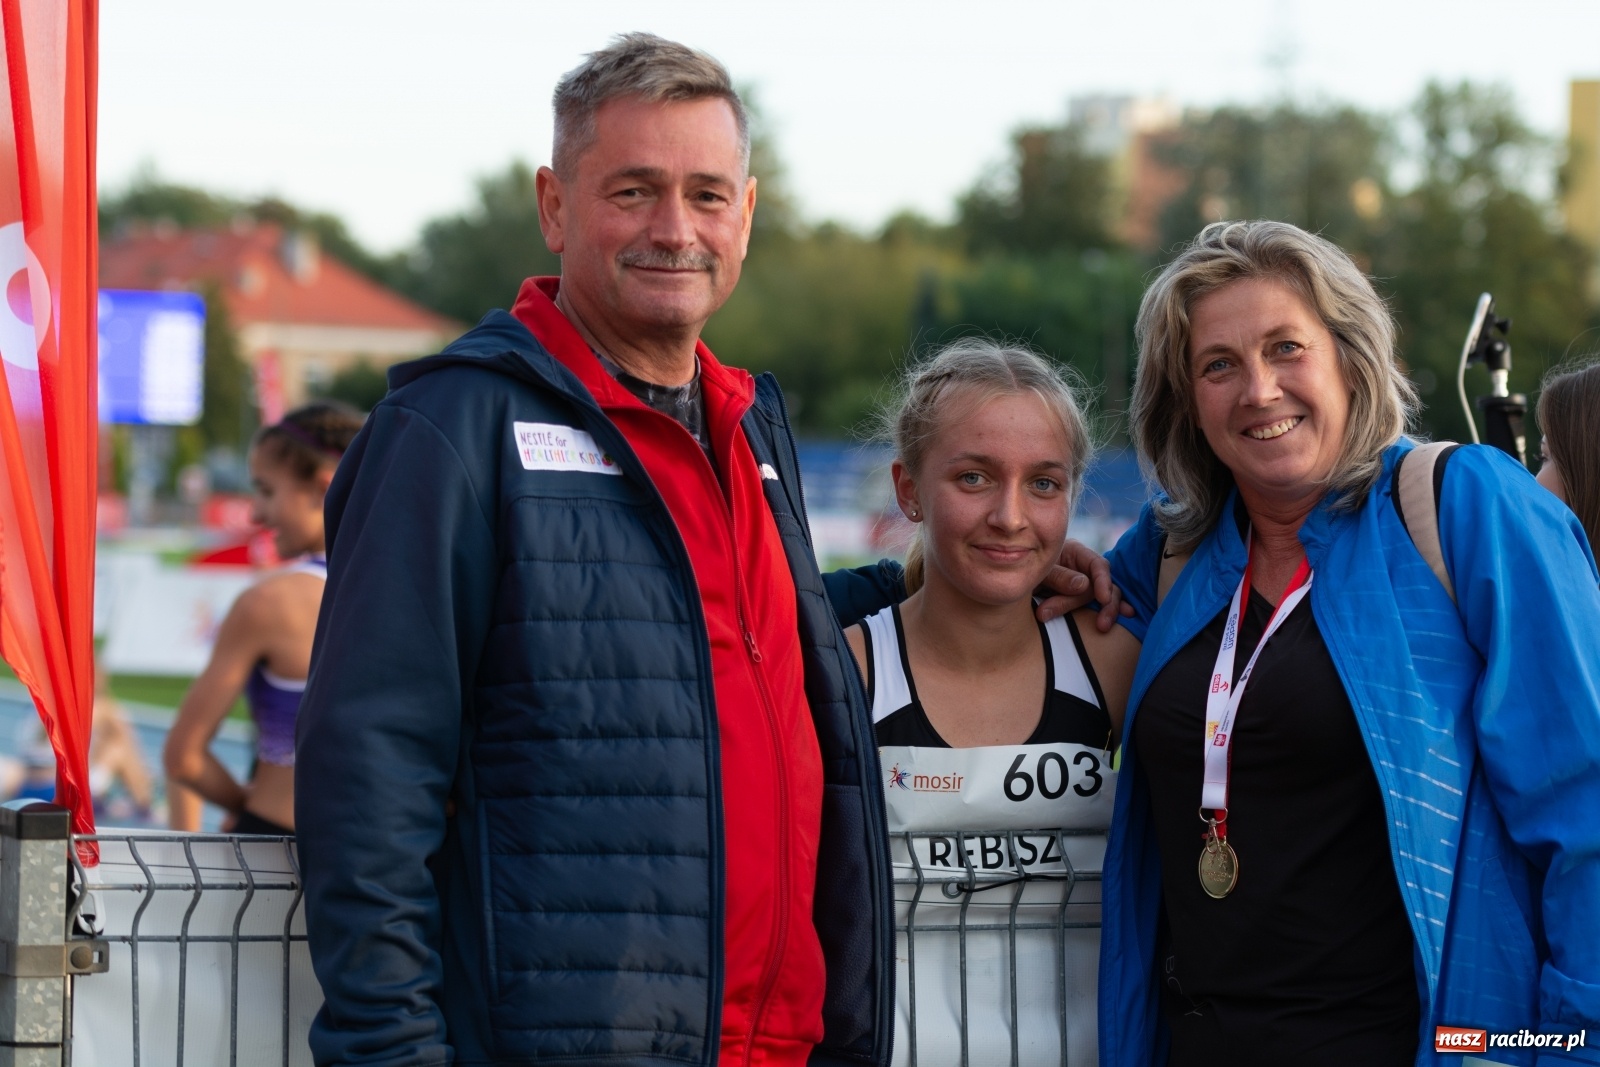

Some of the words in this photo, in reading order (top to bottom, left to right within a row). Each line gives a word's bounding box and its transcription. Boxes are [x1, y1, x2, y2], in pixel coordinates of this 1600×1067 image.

[555, 436, 567, 447] for
[524, 448, 576, 463] HEALTHIER
[579, 452, 602, 466] KIDS
[913, 772, 964, 789] mosir
[1003, 751, 1103, 802] 603
